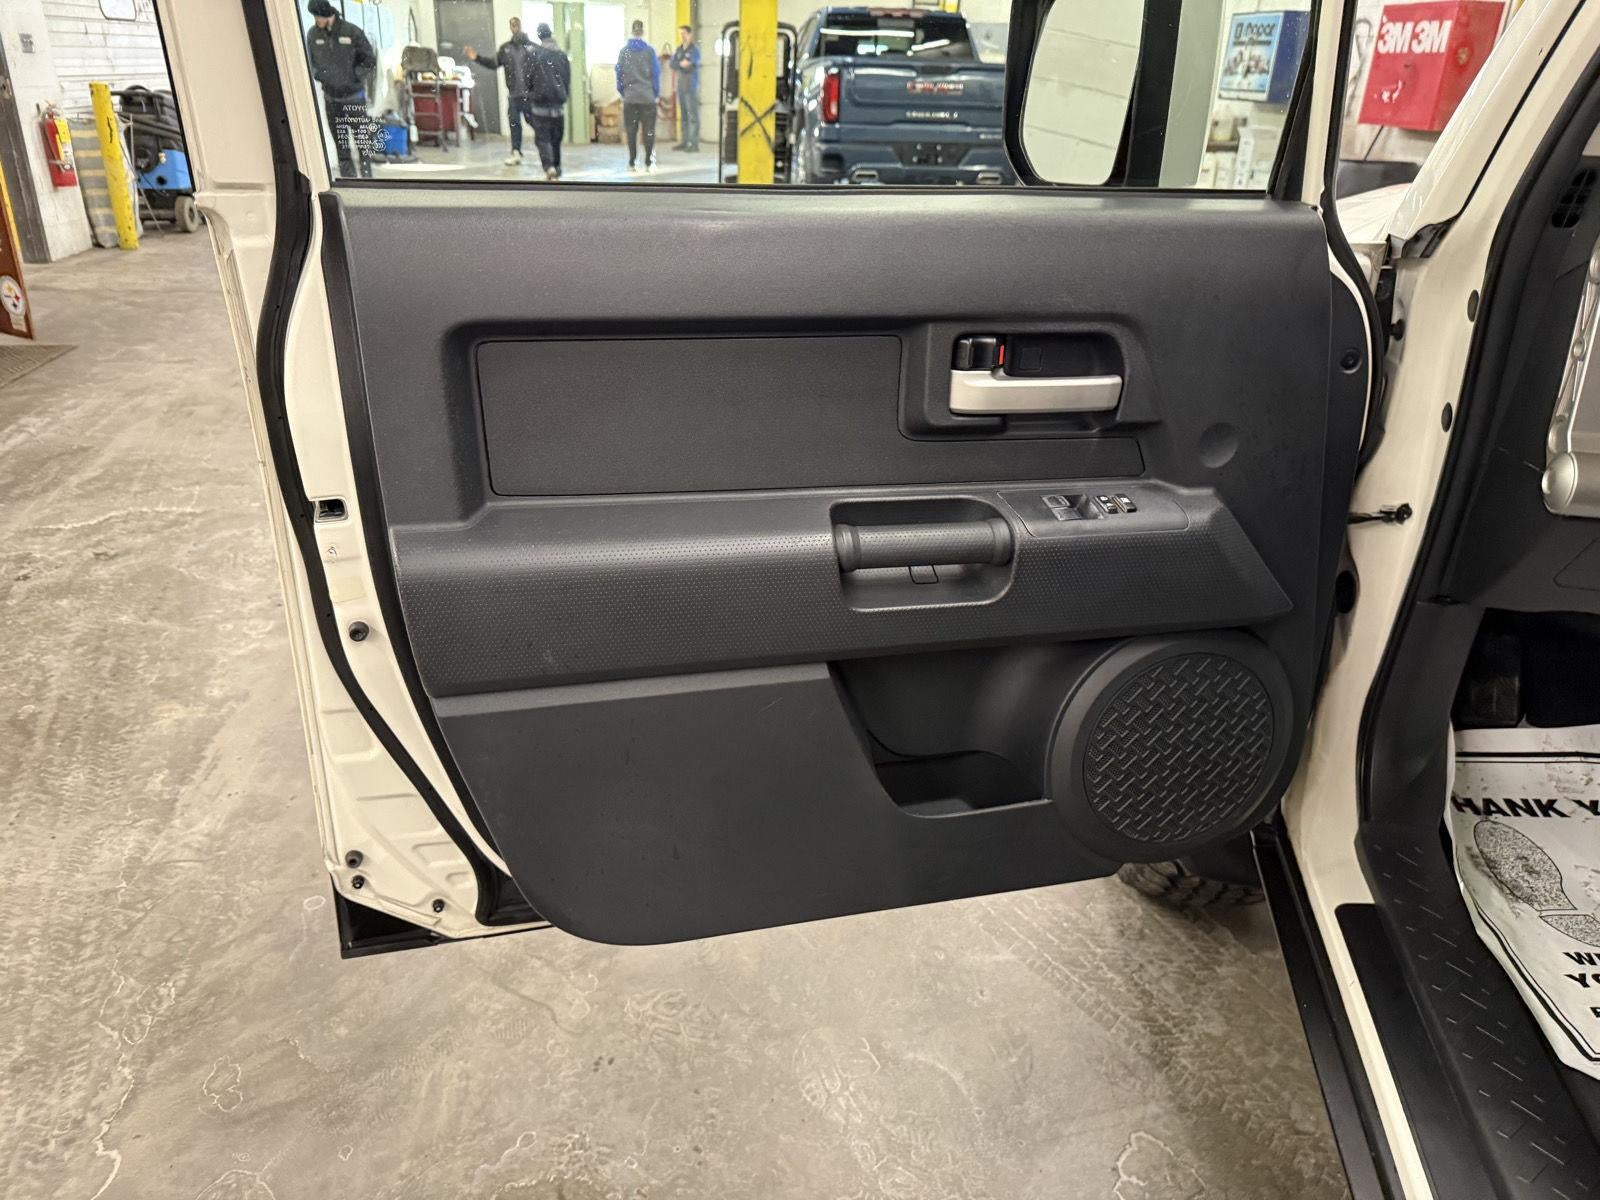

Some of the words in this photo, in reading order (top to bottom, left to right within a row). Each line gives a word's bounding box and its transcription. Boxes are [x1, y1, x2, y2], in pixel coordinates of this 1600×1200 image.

[1377, 21, 1415, 54] 3M
[1411, 19, 1453, 54] 3M
[1451, 797, 1571, 818] HANK
